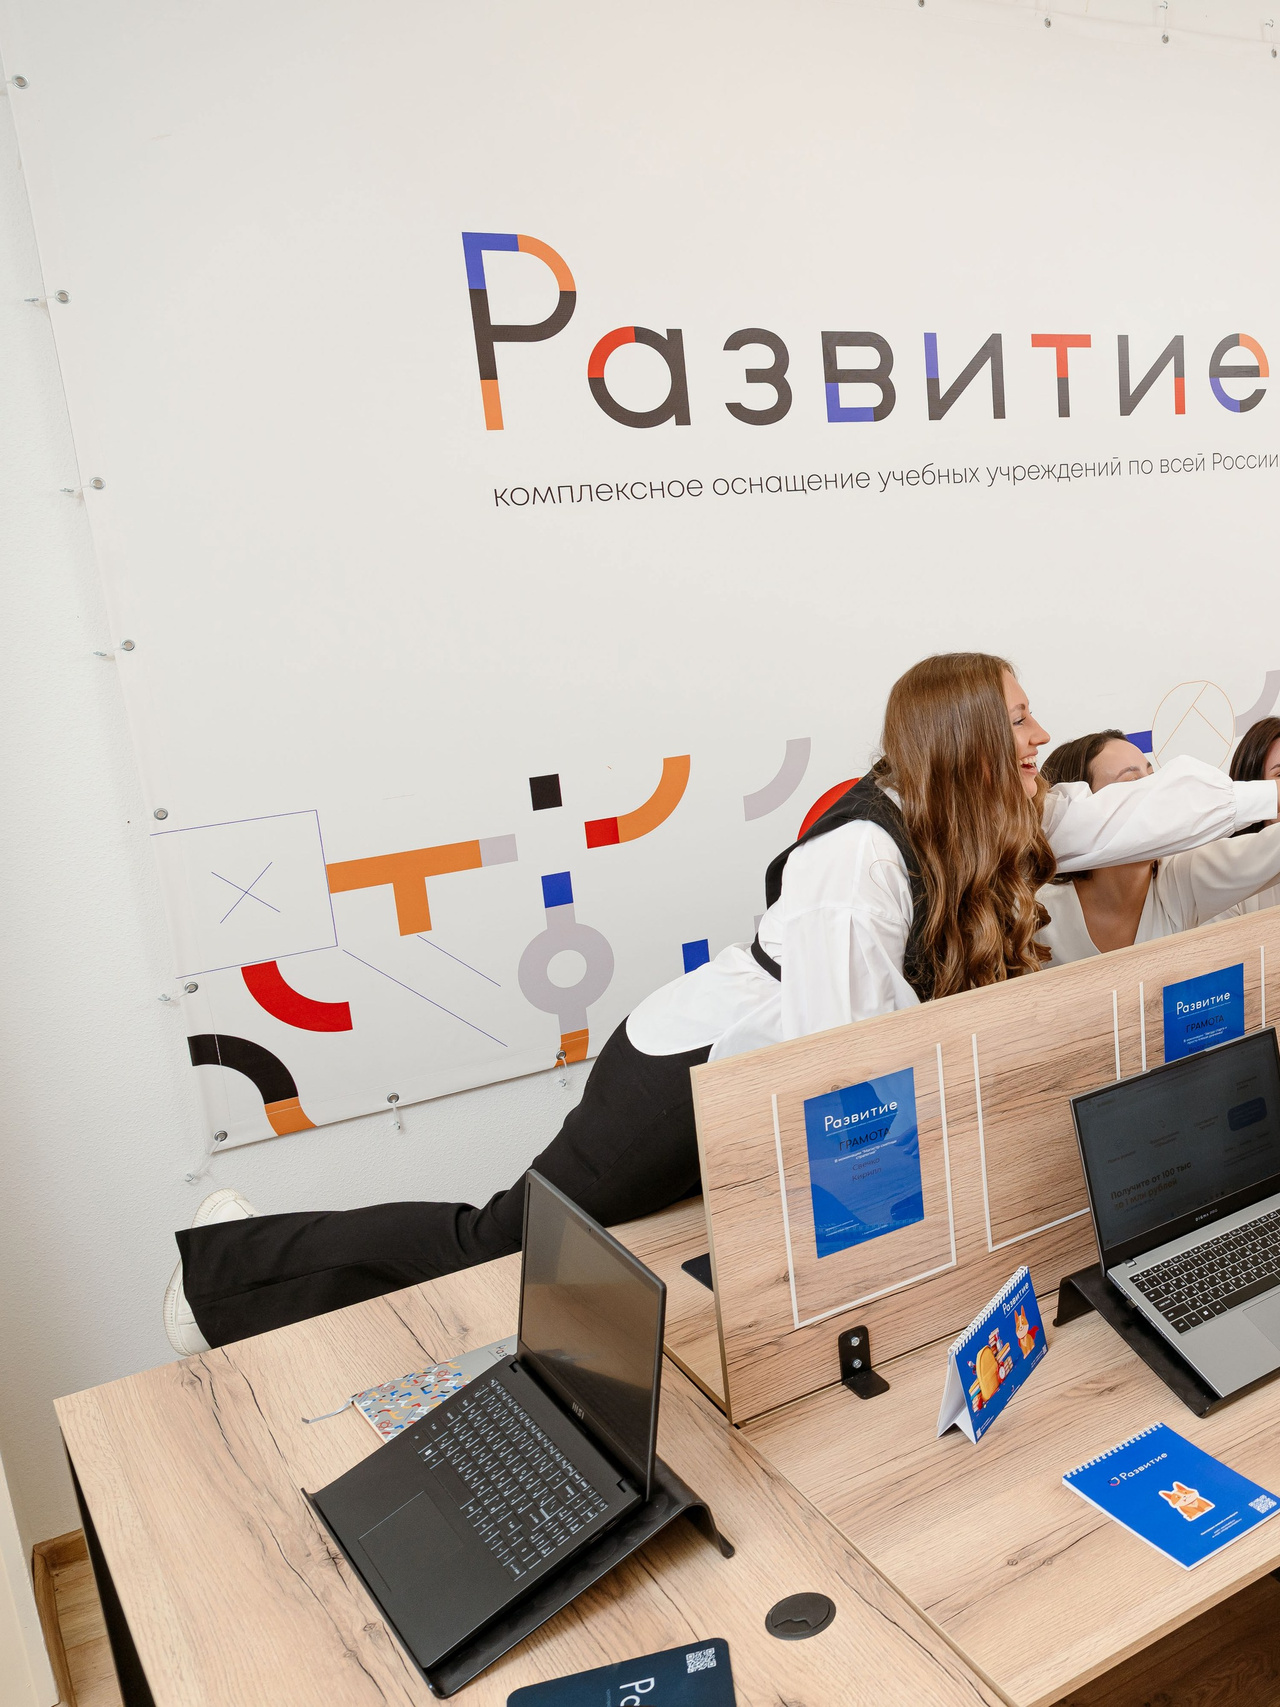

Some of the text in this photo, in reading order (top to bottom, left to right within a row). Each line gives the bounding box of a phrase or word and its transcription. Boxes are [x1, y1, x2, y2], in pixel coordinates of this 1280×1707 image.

[461, 231, 1269, 431] Развитие
[494, 452, 1279, 507] комплексное оснащение учебных учреждений по всей России
[1176, 992, 1231, 1016] Развитие
[1186, 1015, 1224, 1033] ГРАМОТА
[824, 1101, 898, 1132] Развитие
[840, 1128, 891, 1151] ГРАМОТА
[1110, 1162, 1192, 1200] Получите от 100 тыс
[1148, 1177, 1178, 1198] рублей
[1002, 1282, 1030, 1315] Развитие
[1119, 1452, 1168, 1480] Развитие
